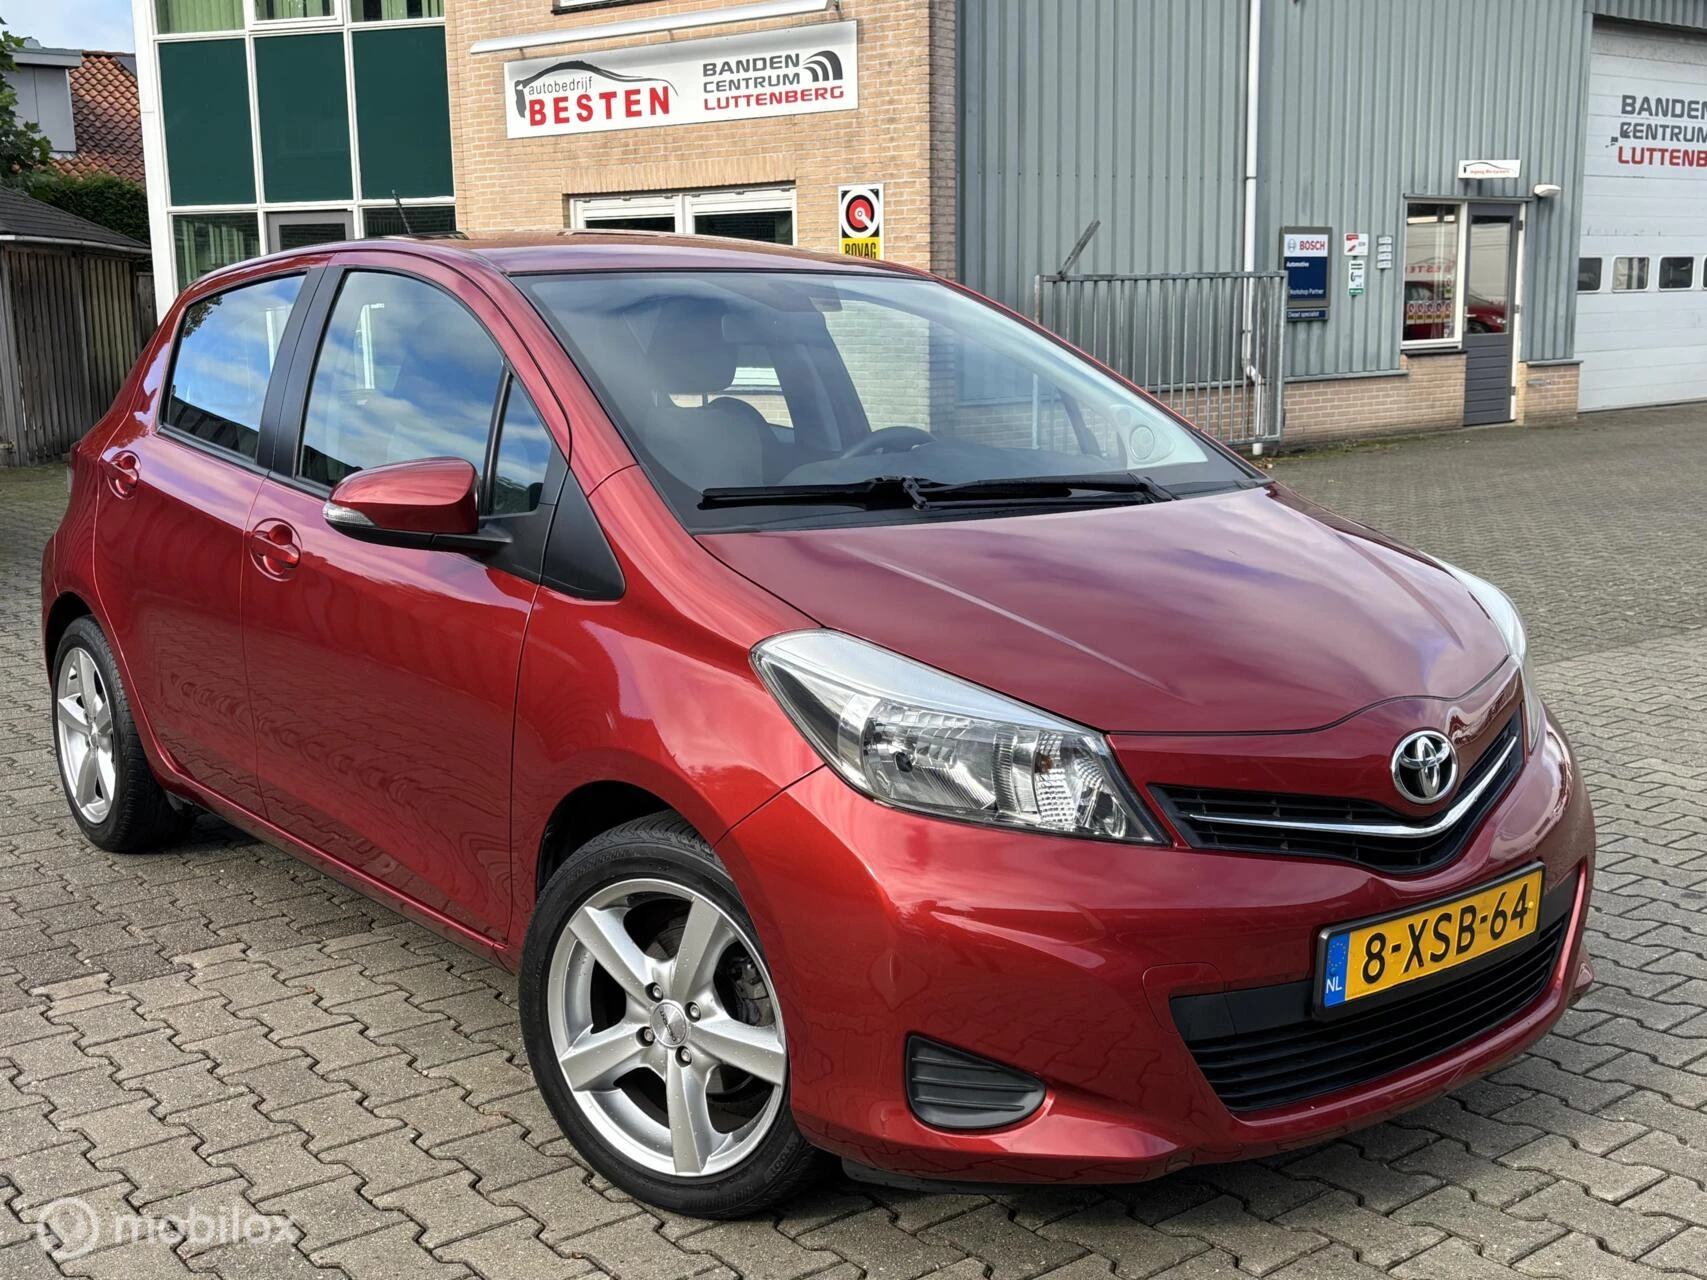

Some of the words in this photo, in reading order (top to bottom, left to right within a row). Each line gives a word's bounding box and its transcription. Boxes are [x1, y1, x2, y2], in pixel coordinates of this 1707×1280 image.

[703, 53, 800, 77] BANDEN
[528, 76, 593, 96] autobedrijf
[703, 73, 801, 94] CENTRUM
[529, 86, 670, 127] BESTEN
[704, 85, 844, 111] LUTTENBERG
[845, 242, 877, 260] BOVAG
[1299, 241, 1325, 251] BOSCH
[1361, 882, 1529, 985] 8-XSB-64
[1325, 978, 1343, 994] NL
